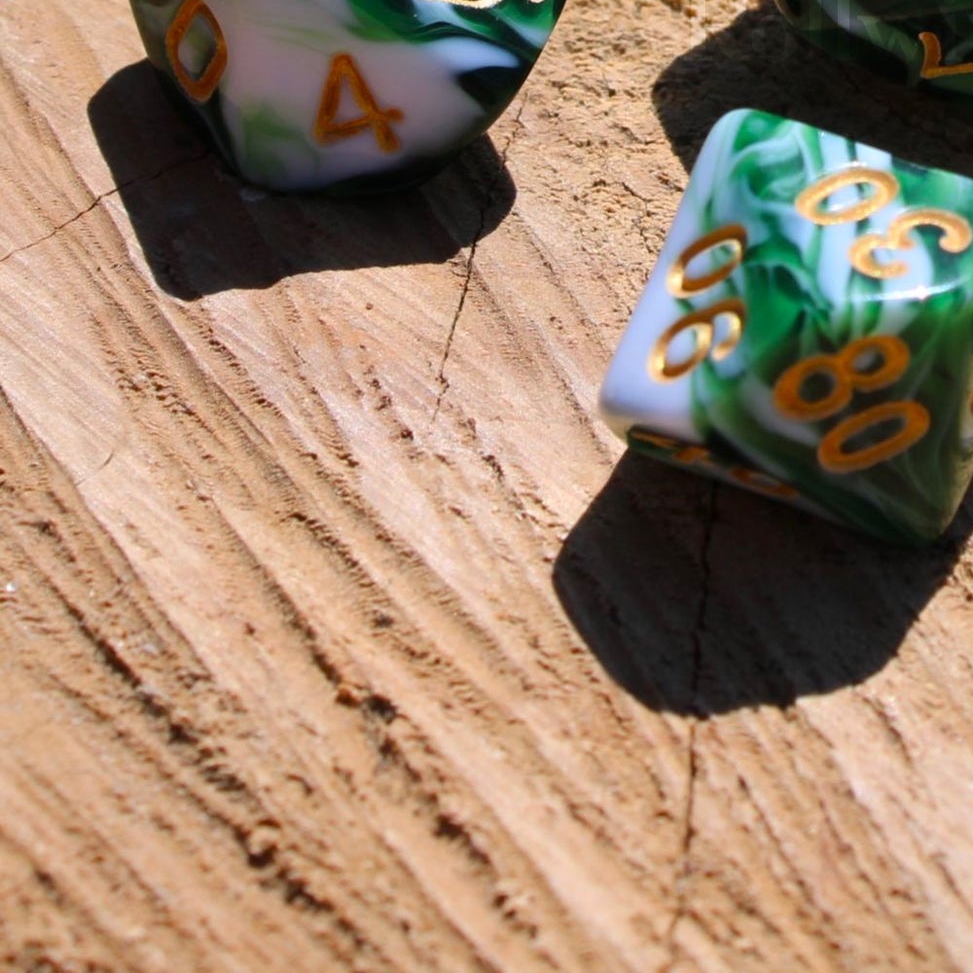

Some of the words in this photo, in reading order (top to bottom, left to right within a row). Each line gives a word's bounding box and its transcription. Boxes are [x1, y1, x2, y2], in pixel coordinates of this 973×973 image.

[312, 53, 404, 153] 4
[795, 166, 973, 280] 30
[773, 334, 930, 473] 80
